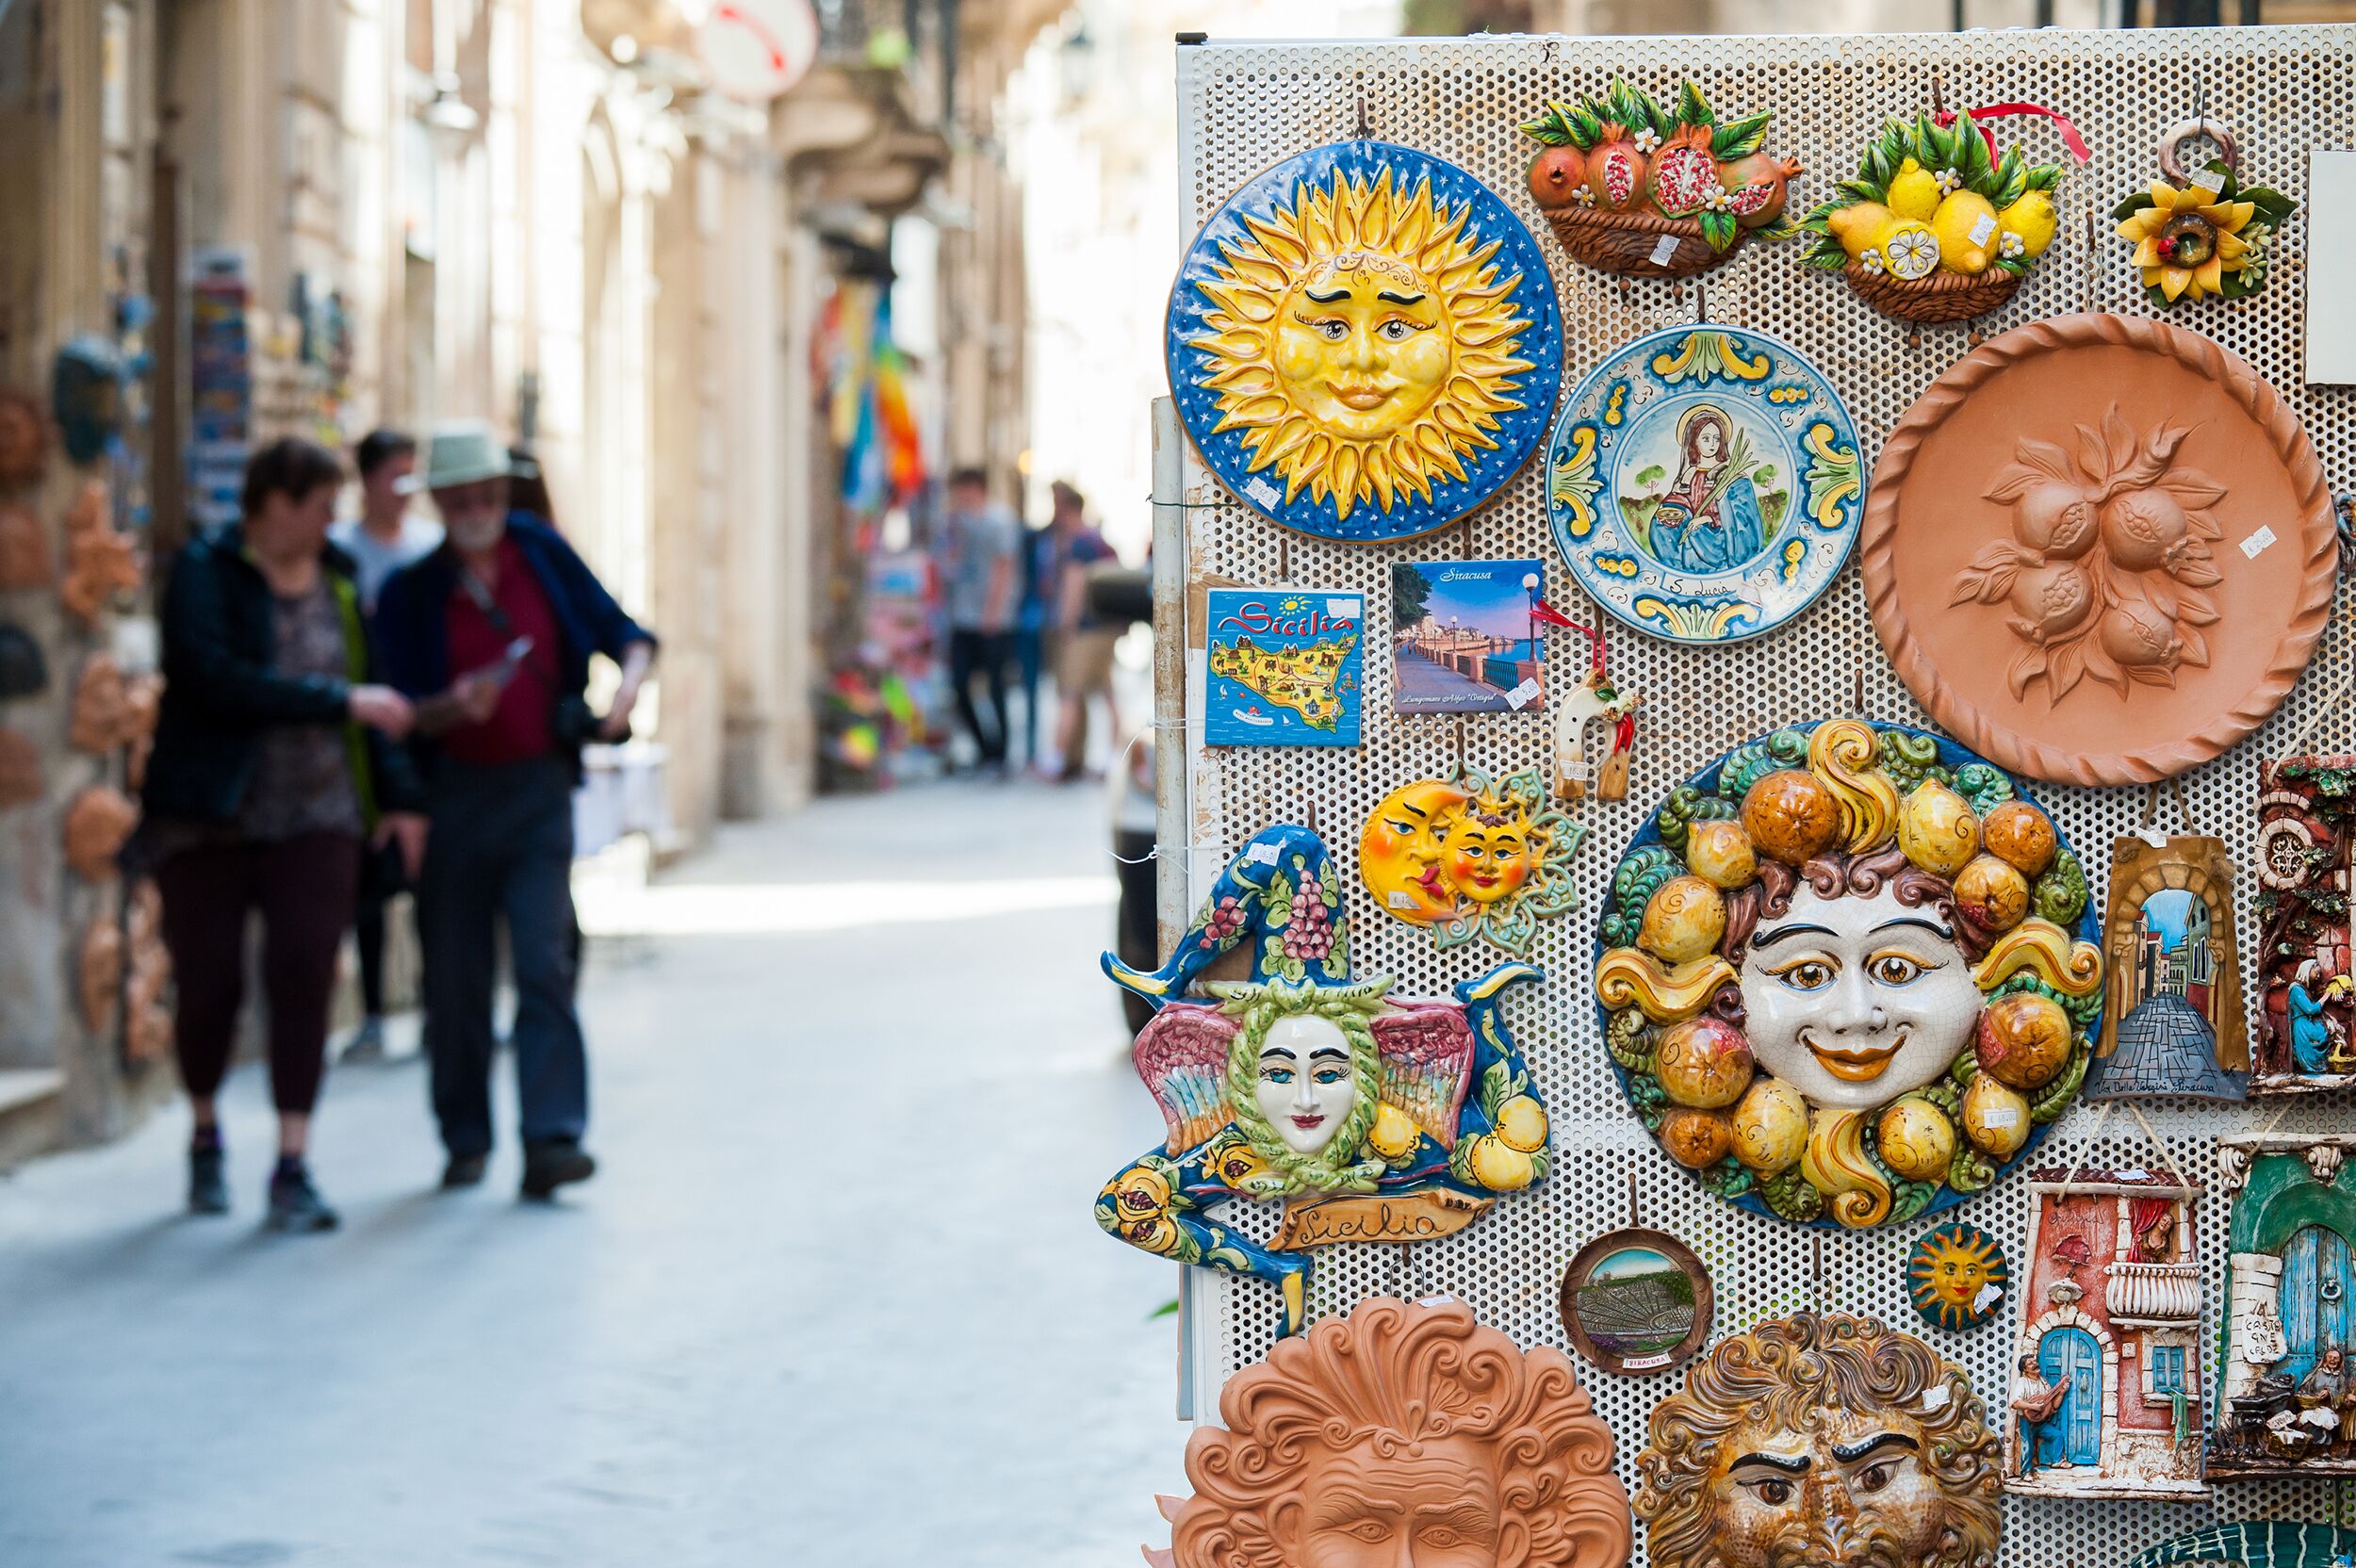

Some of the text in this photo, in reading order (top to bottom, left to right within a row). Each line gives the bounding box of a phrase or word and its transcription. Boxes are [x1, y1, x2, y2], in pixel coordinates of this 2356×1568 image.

[1440, 567, 1492, 582] Siracusa
[1669, 579, 1731, 596] S. Lucia
[1218, 601, 1355, 636] Sicilia
[1301, 1201, 1448, 1245] Sicilia
